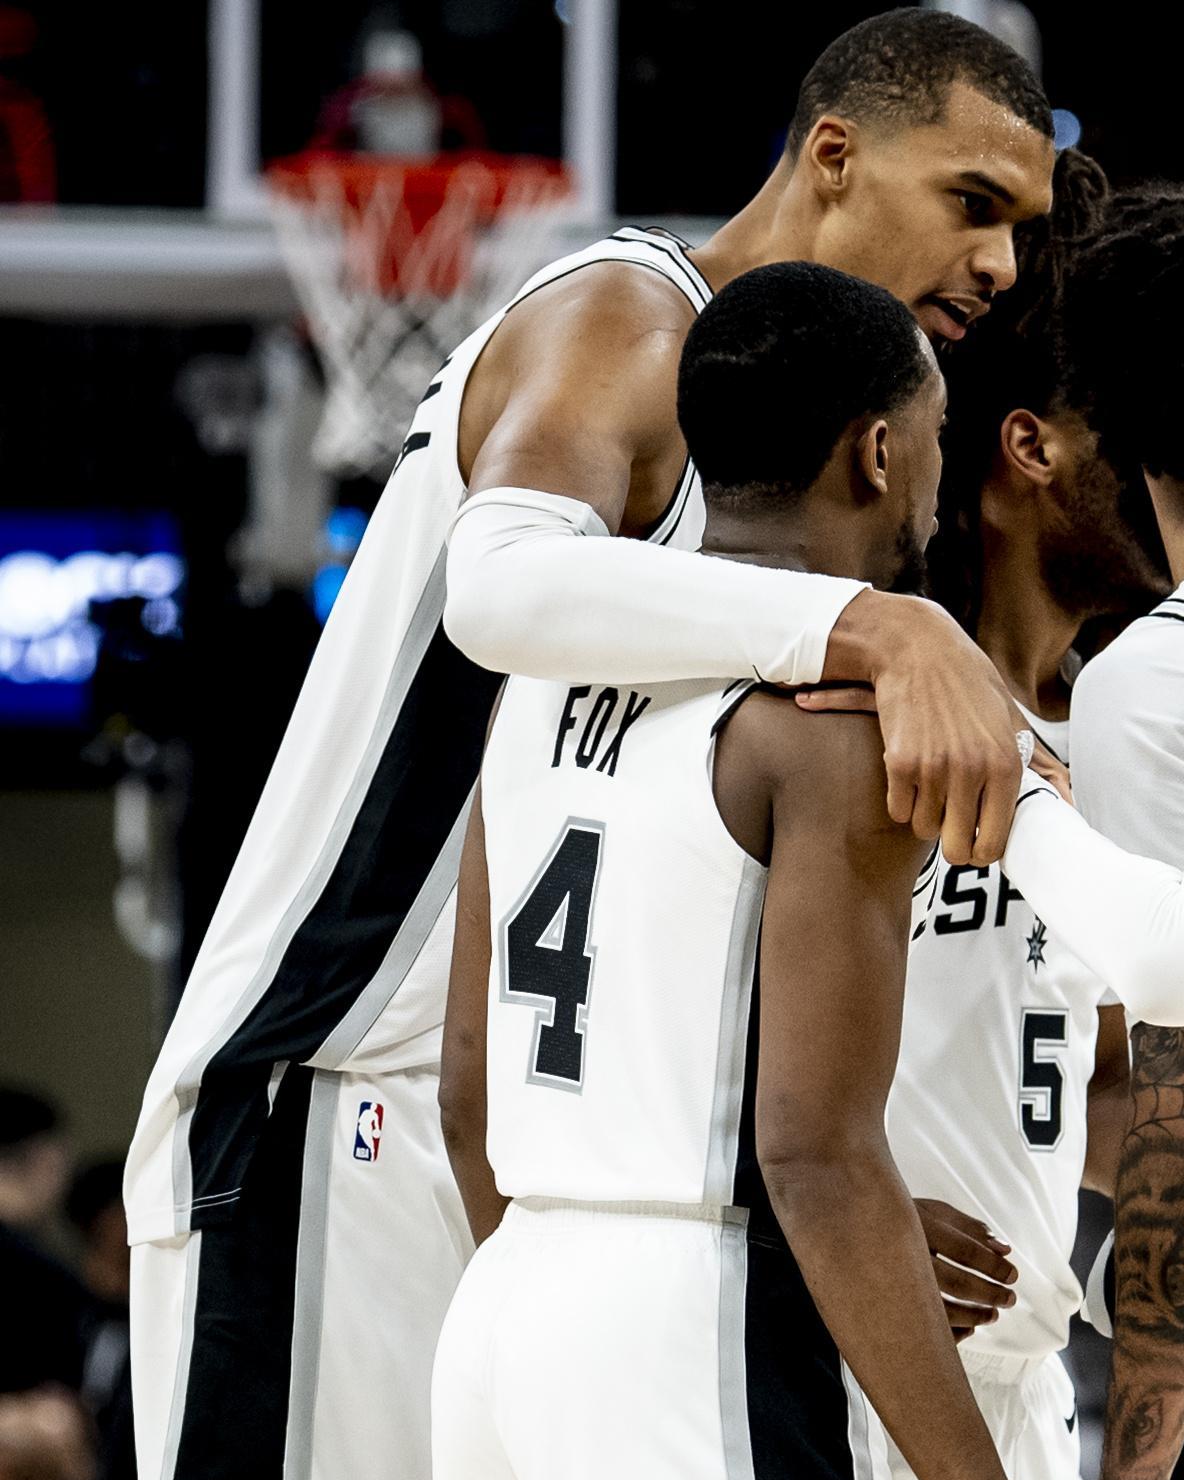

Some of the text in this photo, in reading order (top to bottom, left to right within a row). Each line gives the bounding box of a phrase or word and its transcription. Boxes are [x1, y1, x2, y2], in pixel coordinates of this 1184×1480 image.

[551, 684, 652, 778] FOX
[499, 815, 607, 1097] 4
[1018, 1006, 1070, 1153] 5
